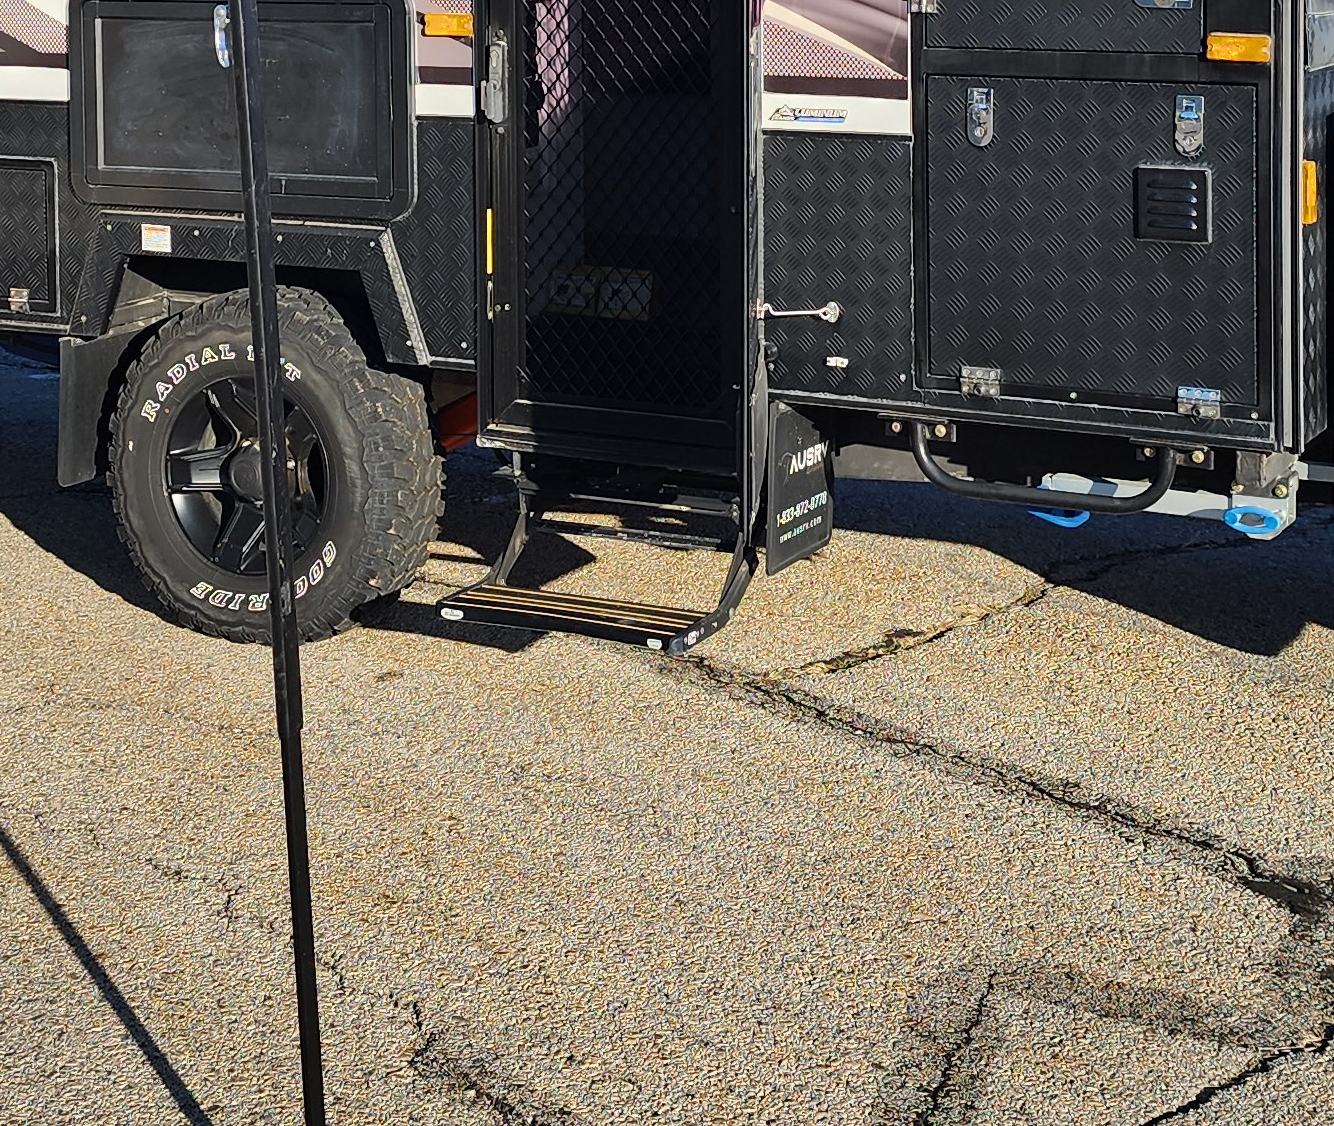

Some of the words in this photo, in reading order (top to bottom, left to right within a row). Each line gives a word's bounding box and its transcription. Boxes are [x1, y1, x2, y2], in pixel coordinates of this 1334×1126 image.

[141, 344, 235, 422] RADIAL
[789, 440, 829, 474] AUSRV
[190, 540, 336, 612] GOORIDE
